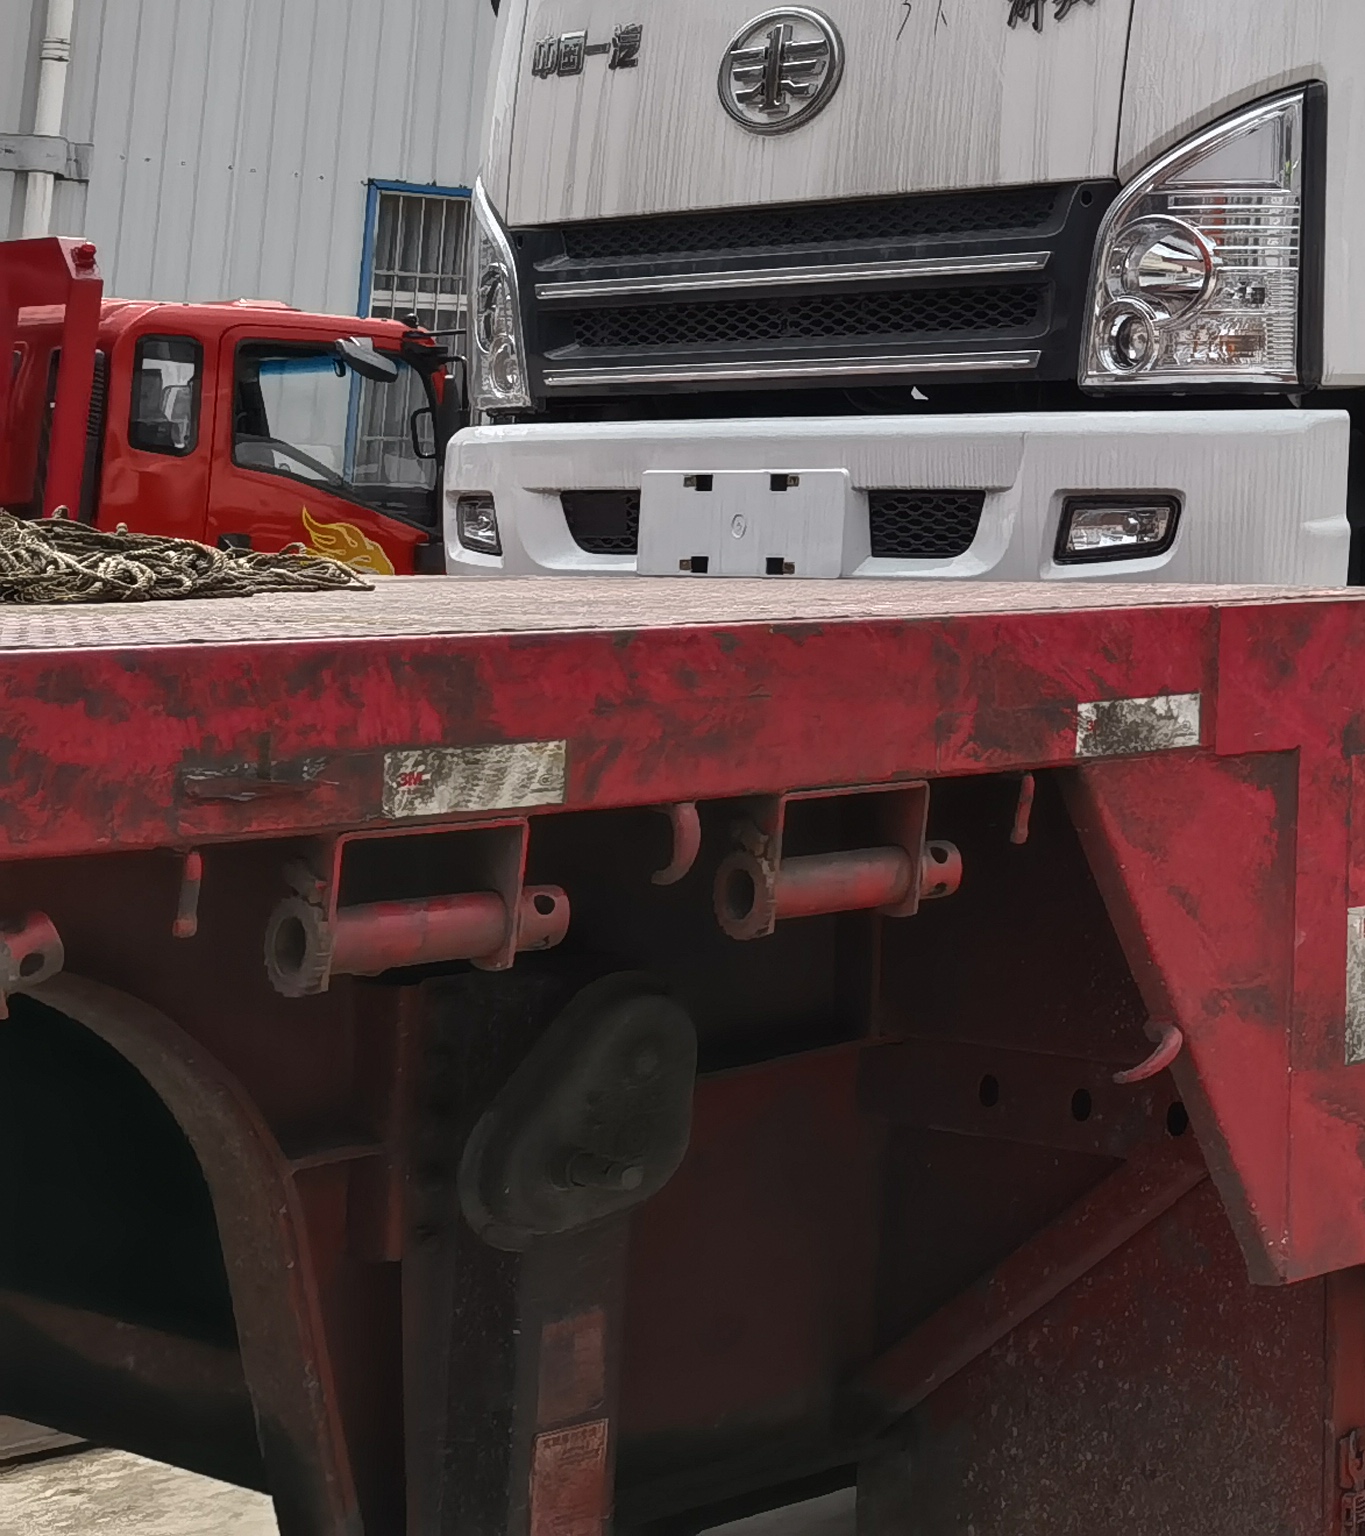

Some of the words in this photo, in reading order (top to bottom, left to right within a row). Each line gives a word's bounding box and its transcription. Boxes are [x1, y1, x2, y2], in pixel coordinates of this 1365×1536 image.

[532, 23, 643, 79] 中国一汽
[400, 772, 423, 788] 3M
